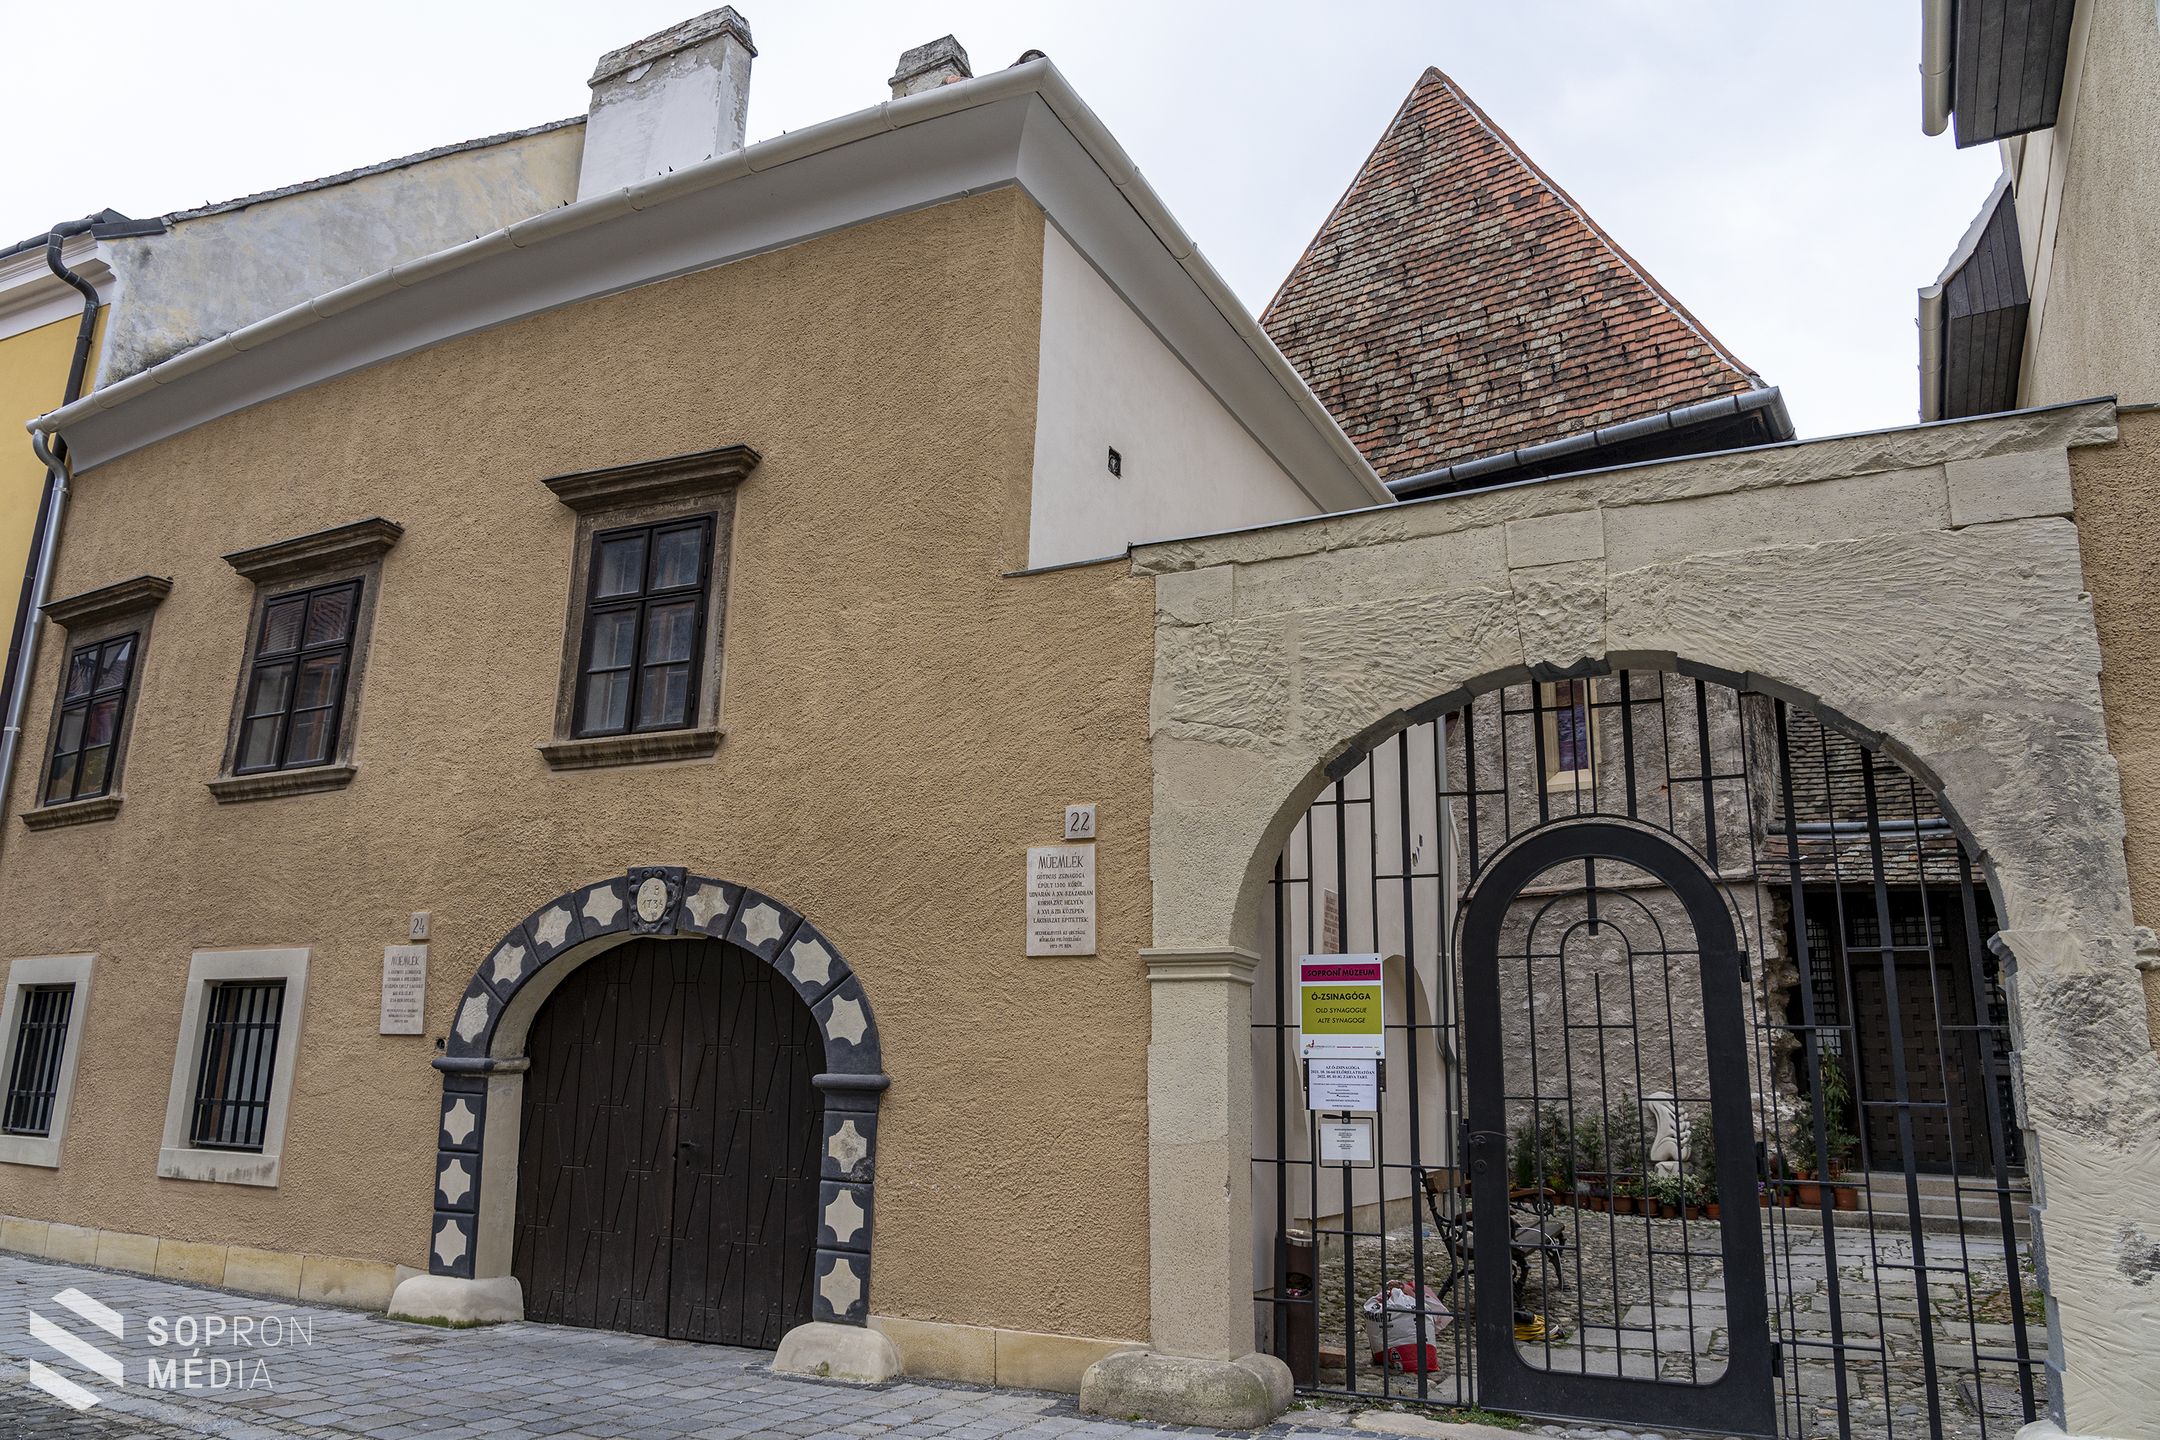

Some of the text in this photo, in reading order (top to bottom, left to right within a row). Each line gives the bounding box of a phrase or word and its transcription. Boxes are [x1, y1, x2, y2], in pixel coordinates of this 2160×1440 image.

[1070, 812, 1090, 832] 22
[412, 917, 426, 934] 24
[1307, 968, 1375, 977] SOPRONI MÚZEUM
[1311, 992, 1371, 1001] Ó-ZSINAGÓGA
